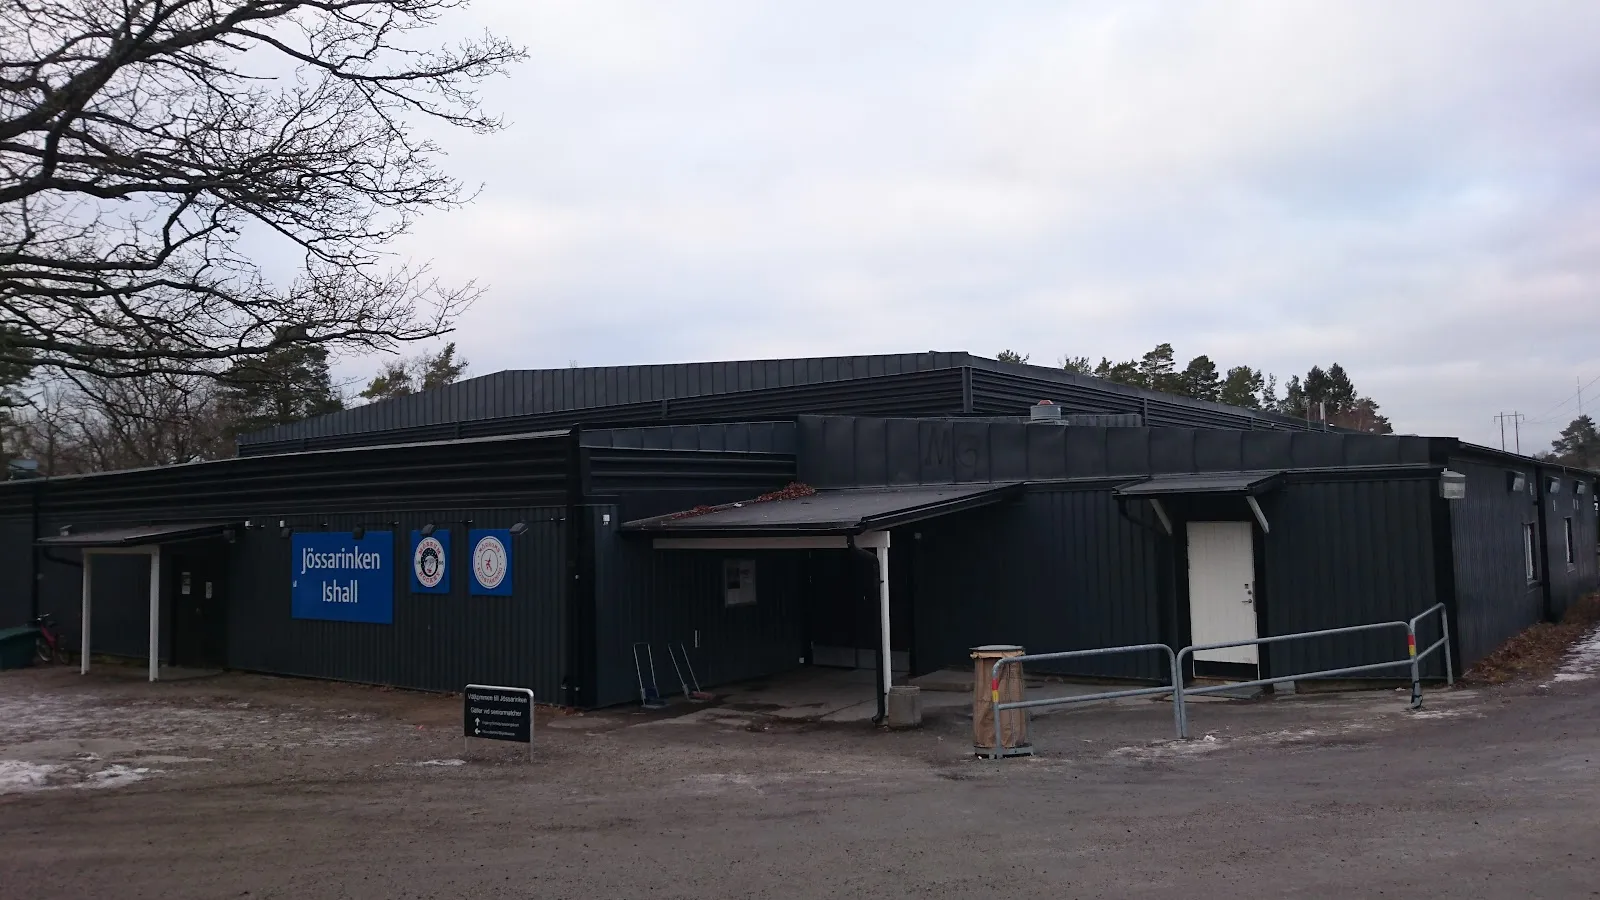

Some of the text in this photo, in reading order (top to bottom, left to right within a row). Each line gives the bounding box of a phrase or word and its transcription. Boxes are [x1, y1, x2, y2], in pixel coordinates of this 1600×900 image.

[418, 541, 441, 555] MÖRRUM
[479, 542, 500, 553] MÖRRUMS
[301, 546, 380, 574] Jössarinken
[419, 571, 441, 583] HOCKEY
[322, 579, 358, 603] Ishall
[468, 693, 493, 701] Välkommen
